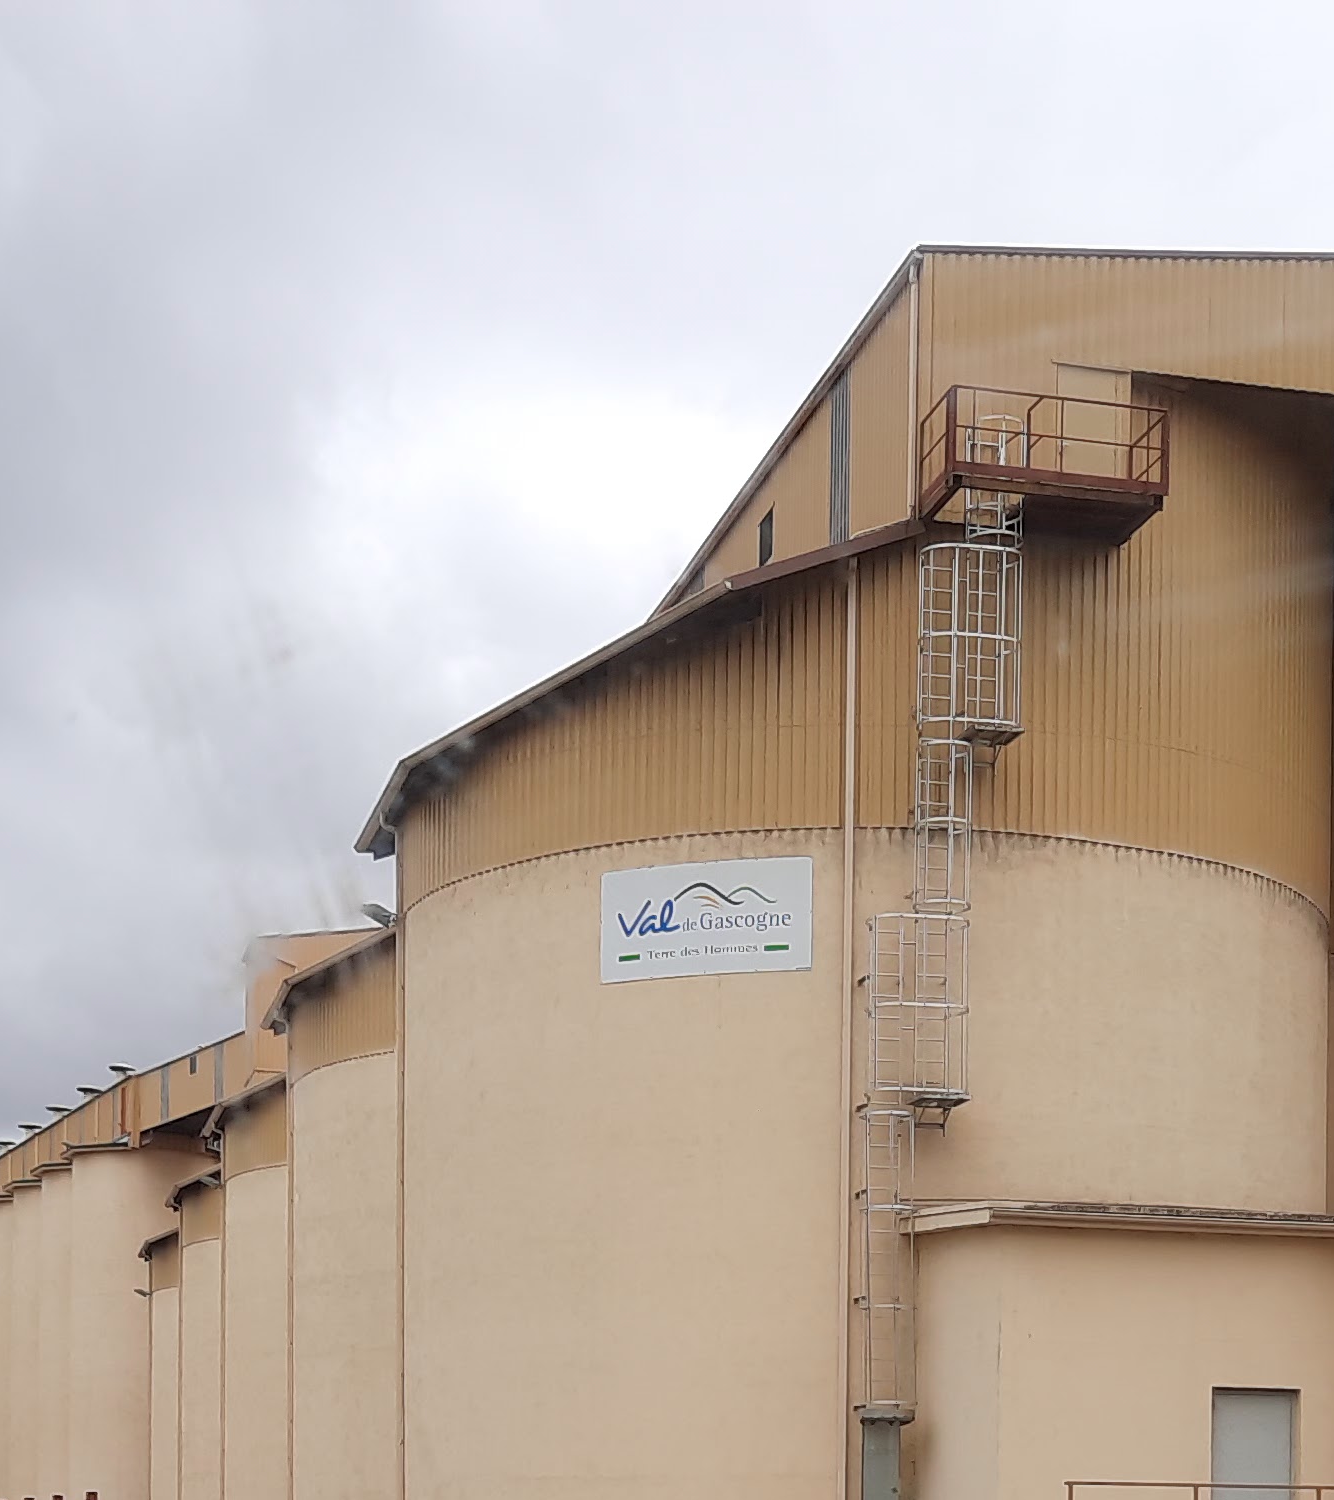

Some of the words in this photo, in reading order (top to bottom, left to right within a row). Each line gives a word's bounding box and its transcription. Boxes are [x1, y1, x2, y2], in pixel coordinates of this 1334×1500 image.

[618, 900, 680, 937] Val
[682, 918, 698, 932] de
[700, 911, 792, 932] Gascogne
[647, 949, 676, 960] Terre
[680, 946, 701, 957] des
